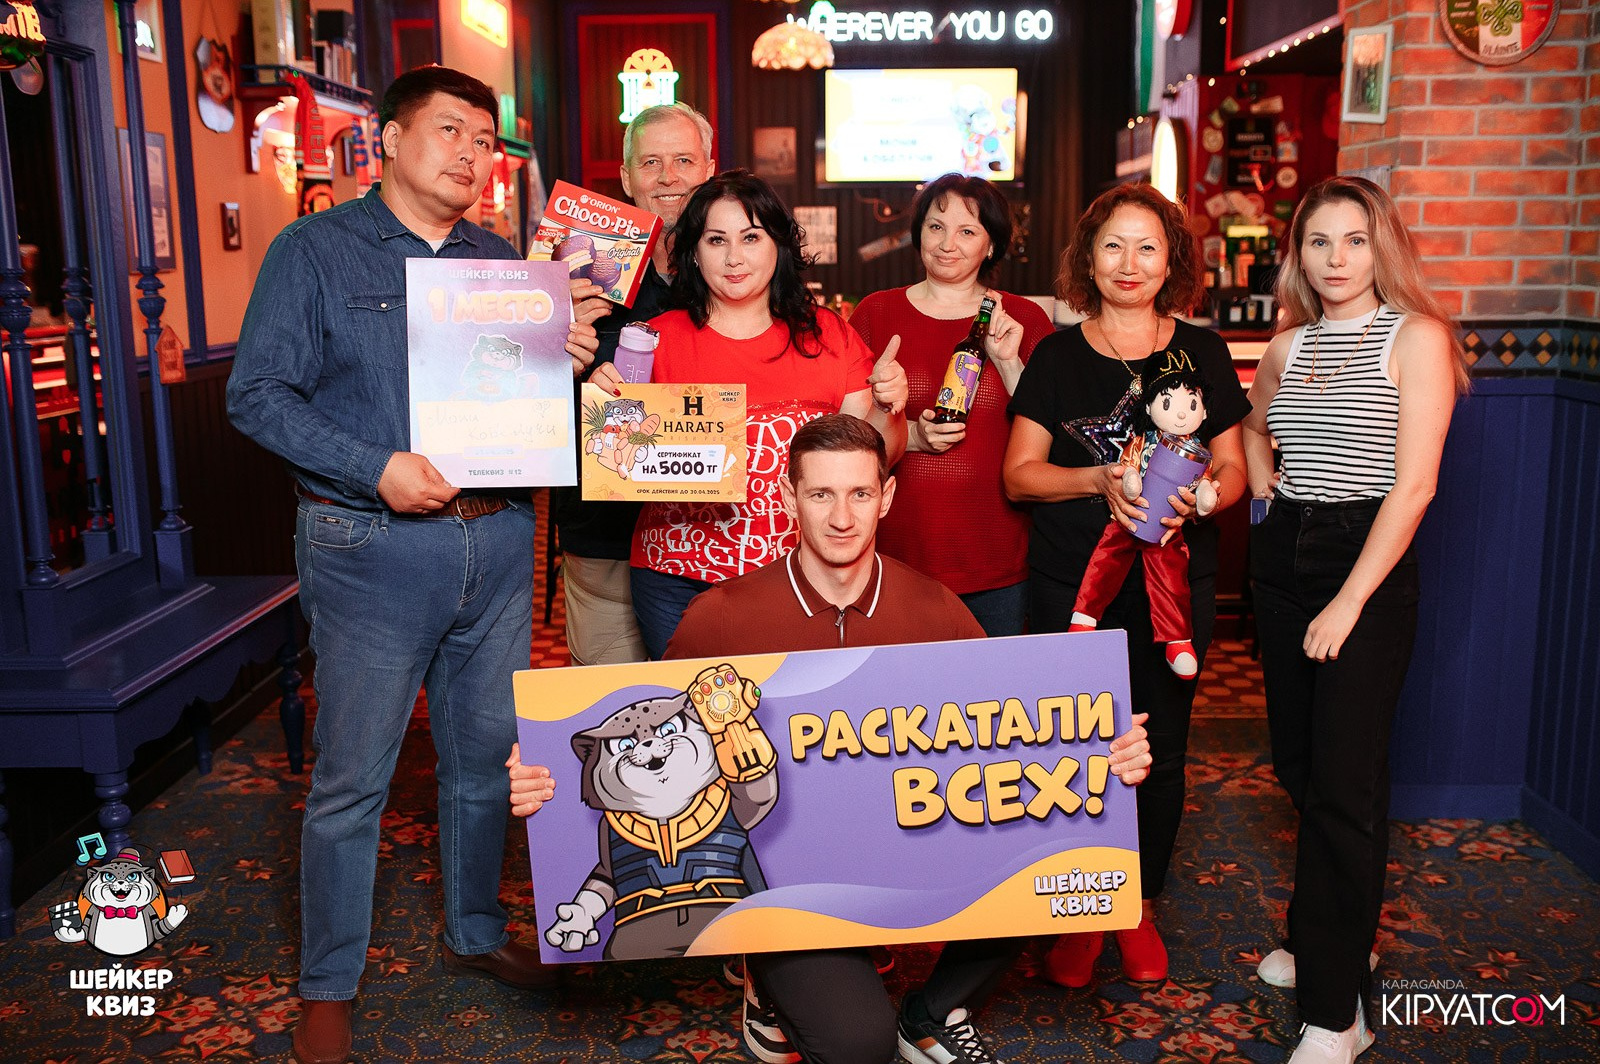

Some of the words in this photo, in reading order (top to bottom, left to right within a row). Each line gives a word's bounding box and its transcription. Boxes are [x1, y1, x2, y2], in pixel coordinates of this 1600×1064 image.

[950, 10, 1006, 41] YOU
[1014, 9, 1054, 41] GO
[590, 198, 618, 214] ORION
[608, 246, 641, 259] Original
[450, 267, 495, 280] ШЕЙКЕР
[498, 270, 529, 280] КВИЗ
[428, 287, 447, 323] 1
[452, 289, 555, 324] МЕСТО
[663, 421, 725, 433] HARAT'S
[642, 464, 658, 474] НА
[659, 460, 705, 476] 5000
[706, 464, 718, 474] ТГ
[787, 691, 1116, 764] РАСКАТАЛИ
[892, 755, 1110, 831] ВСЕХ!
[1034, 868, 1128, 896] ШЕЙКЕР
[1050, 894, 1113, 918] КВИЗ
